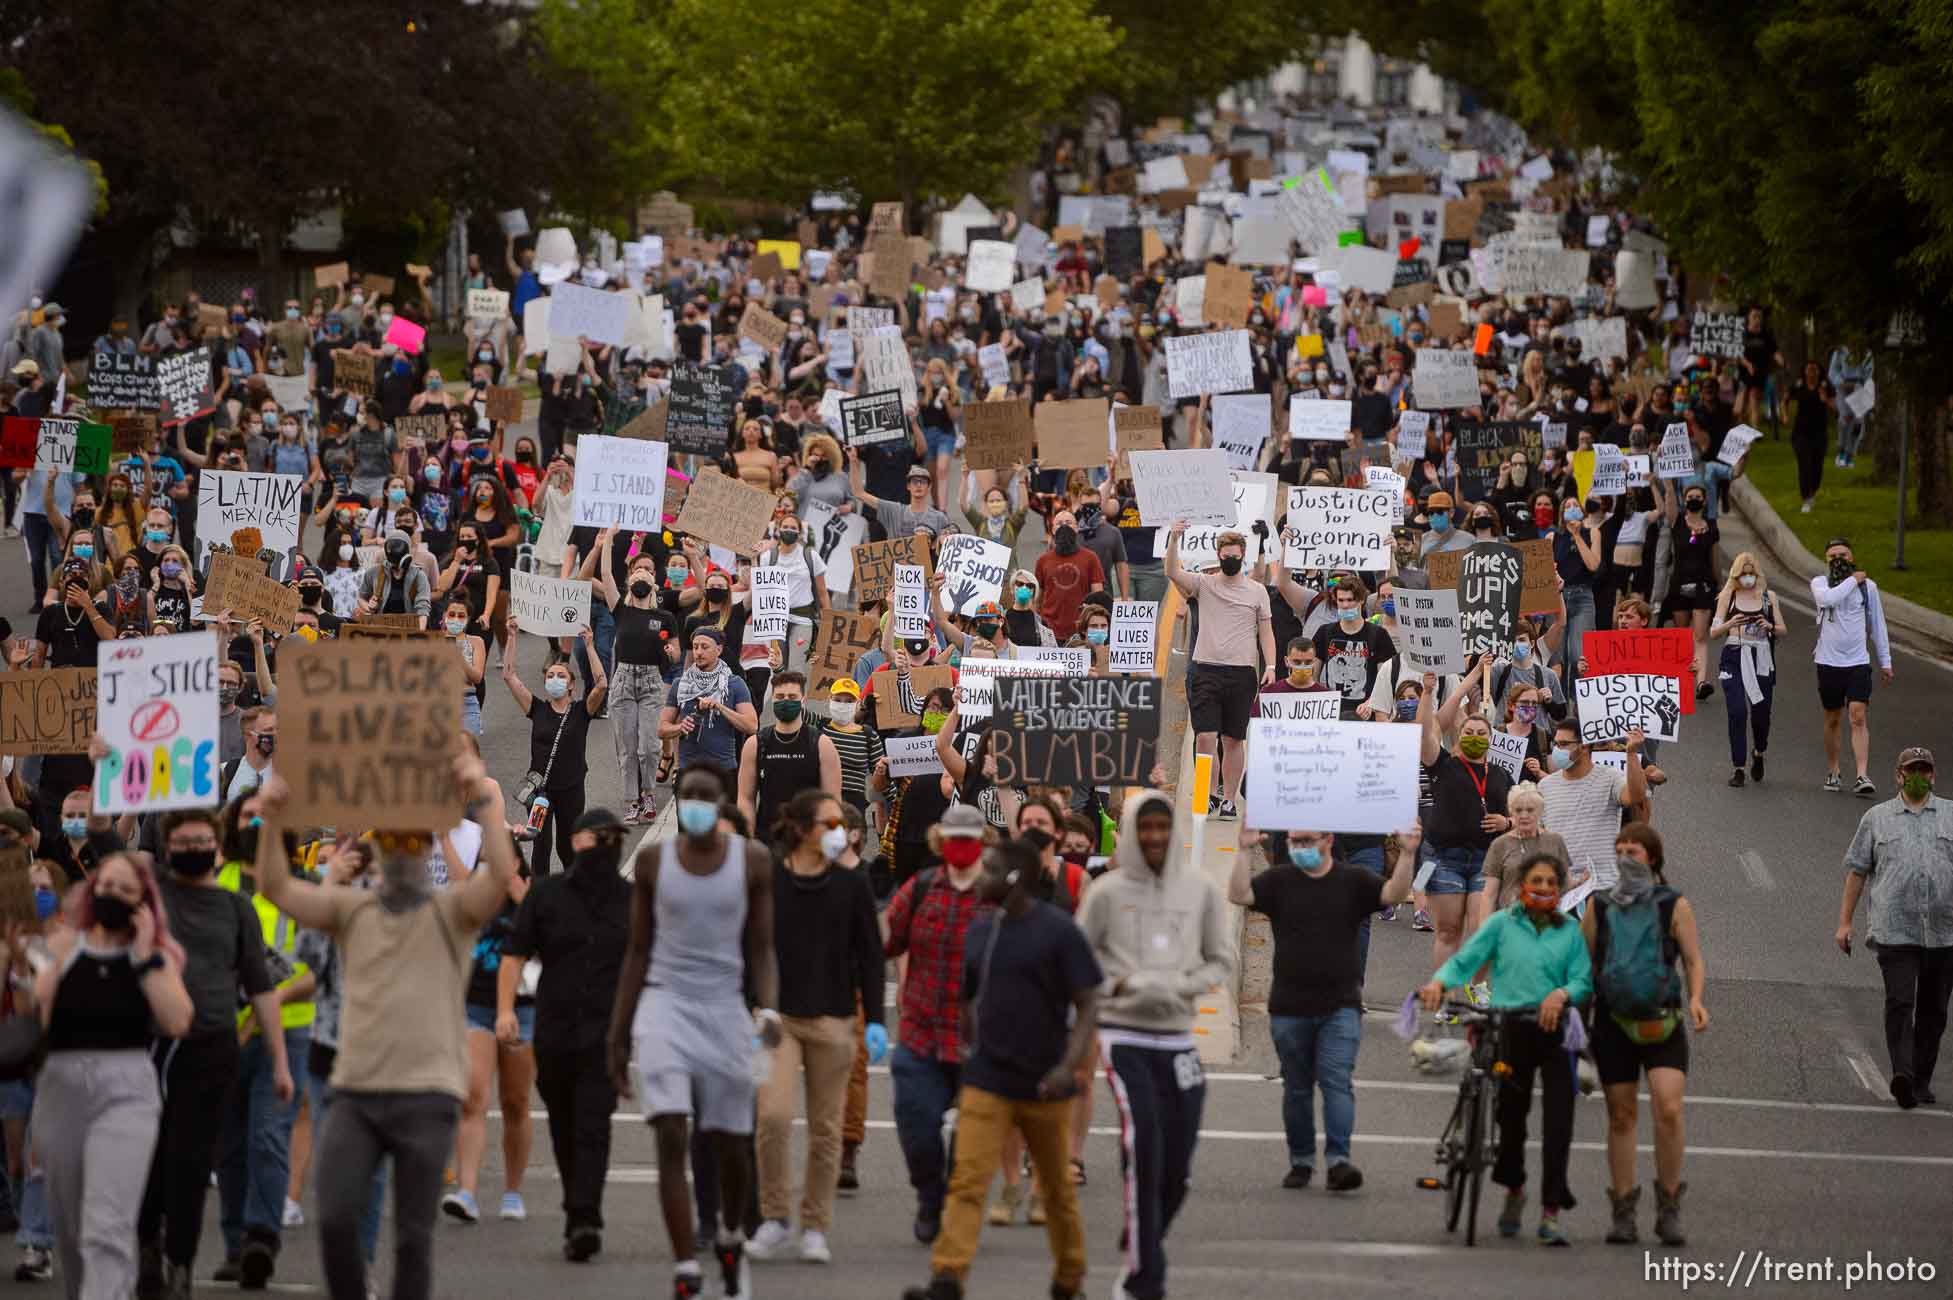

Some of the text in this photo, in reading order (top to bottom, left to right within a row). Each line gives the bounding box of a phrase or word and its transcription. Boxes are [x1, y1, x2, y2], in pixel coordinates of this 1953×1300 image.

[1691, 325, 1743, 344] LIVES
[157, 352, 194, 374] NOT
[36, 421, 80, 439] ATINOS
[1664, 426, 1686, 438] ACK
[1219, 441, 1254, 457] MATTER
[1659, 459, 1694, 471] MATTER
[608, 474, 656, 496] STAND
[1593, 477, 1627, 489] MATTER
[218, 476, 303, 513] LATINX
[1290, 488, 1388, 517] Justice
[222, 507, 285, 528] MEXICA
[582, 502, 656, 526] WITH YOU
[1325, 510, 1351, 524] for
[1289, 527, 1380, 550] Breonna
[856, 537, 914, 565] BLACK
[1297, 547, 1368, 568] Taylor
[512, 574, 548, 597] BLACK
[756, 571, 787, 585] BLACK
[759, 594, 787, 610] LIVES
[1415, 597, 1434, 609] SYSTEM
[1466, 575, 1508, 610] UP!
[1115, 605, 1154, 619] BLACK
[1400, 614, 1411, 626] WAS
[1414, 616, 1429, 629] NEVER
[1499, 608, 1511, 636] 4
[753, 617, 788, 633] MATTE
[896, 617, 924, 631] TTER
[1117, 629, 1149, 643] LIVES
[1421, 636, 1433, 648] WAS
[1036, 652, 1083, 661] JUSTICE
[1110, 651, 1153, 665] MATTER
[295, 651, 450, 696] BLACK
[960, 687, 993, 705] CHAN
[992, 678, 1155, 711] WHITE SILENCE
[1579, 675, 1679, 698] JUSTICE
[0, 677, 66, 743] NO
[1261, 698, 1339, 720] NO JUSTICE
[1605, 694, 1657, 717] FOR
[307, 702, 452, 749] LIVES
[1024, 709, 1117, 730] IS VIOLENCE
[1582, 713, 1651, 741] GEORGE
[904, 740, 937, 751] JUST
[1491, 734, 1524, 755] LACK
